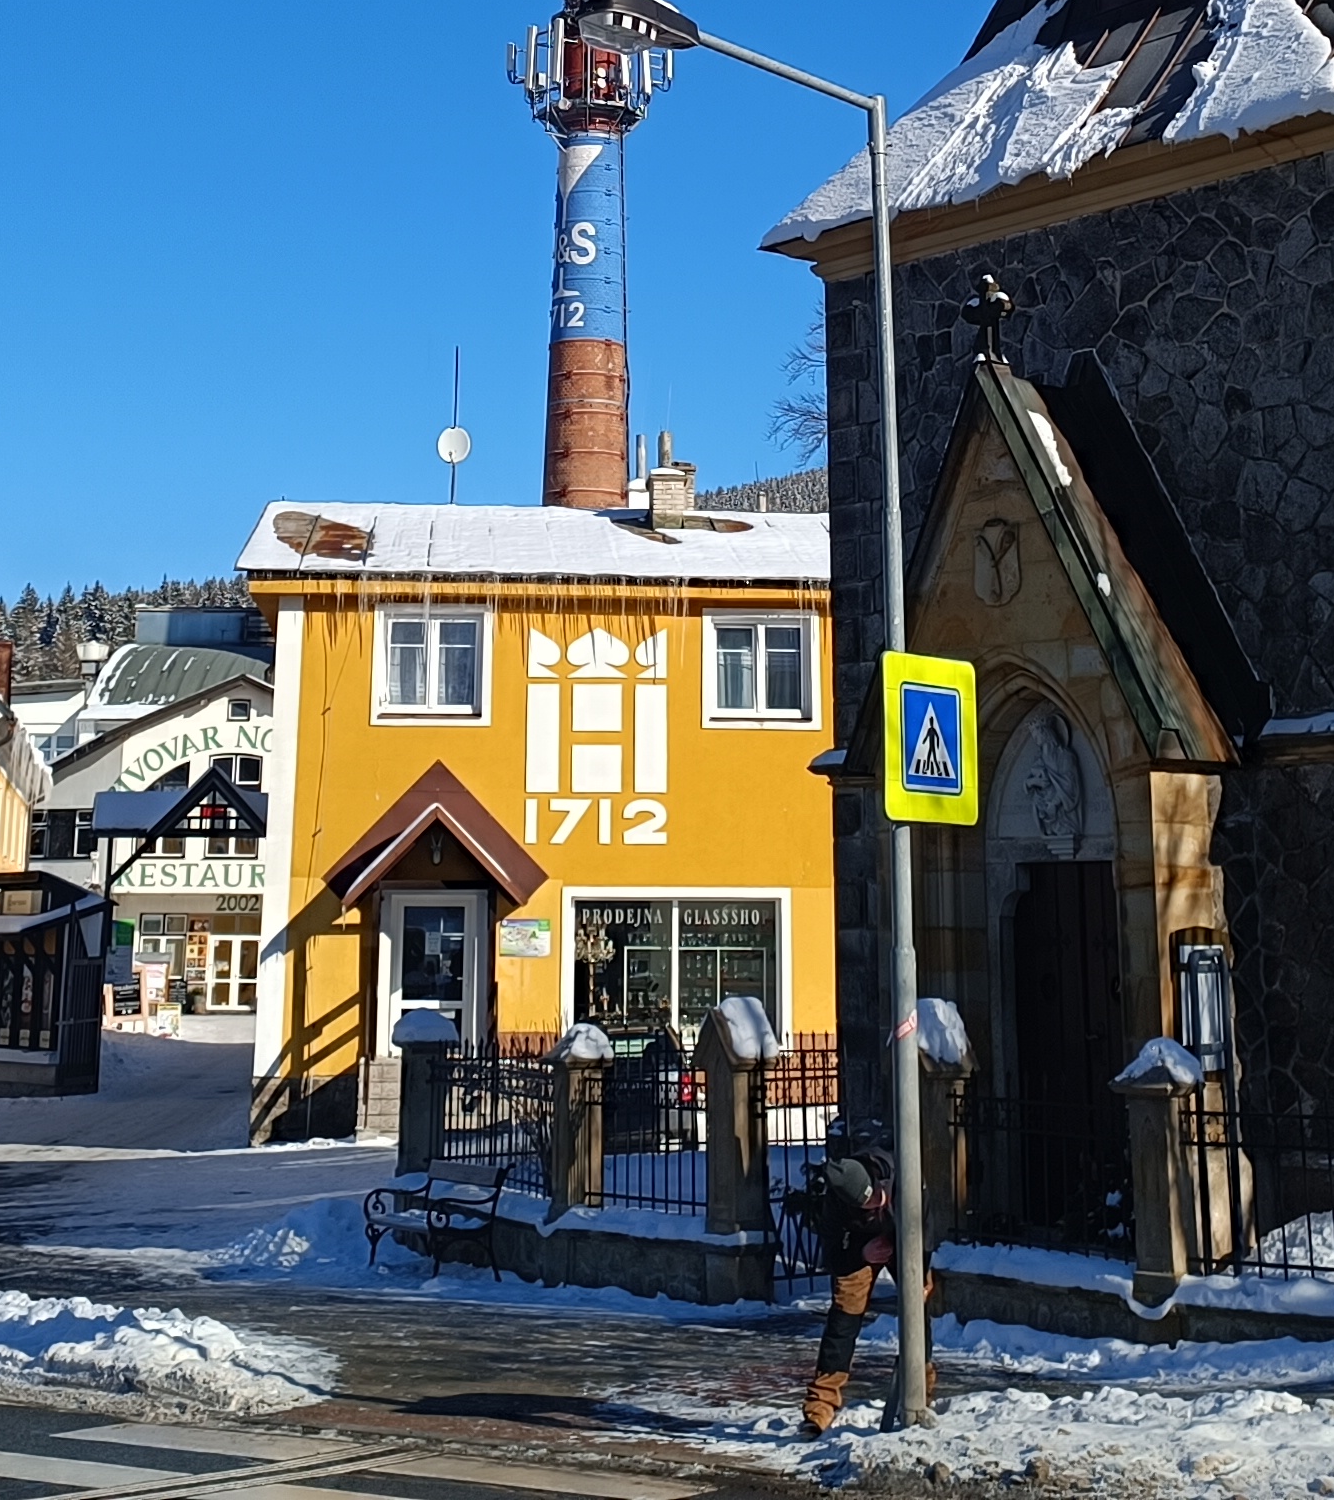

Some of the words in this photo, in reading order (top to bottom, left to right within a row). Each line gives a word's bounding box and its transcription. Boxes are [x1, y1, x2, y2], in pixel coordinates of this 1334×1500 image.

[555, 221, 597, 265] &S
[524, 798, 668, 845] 1712
[215, 894, 260, 912] 2002
[581, 908, 663, 927] PRODEJNA
